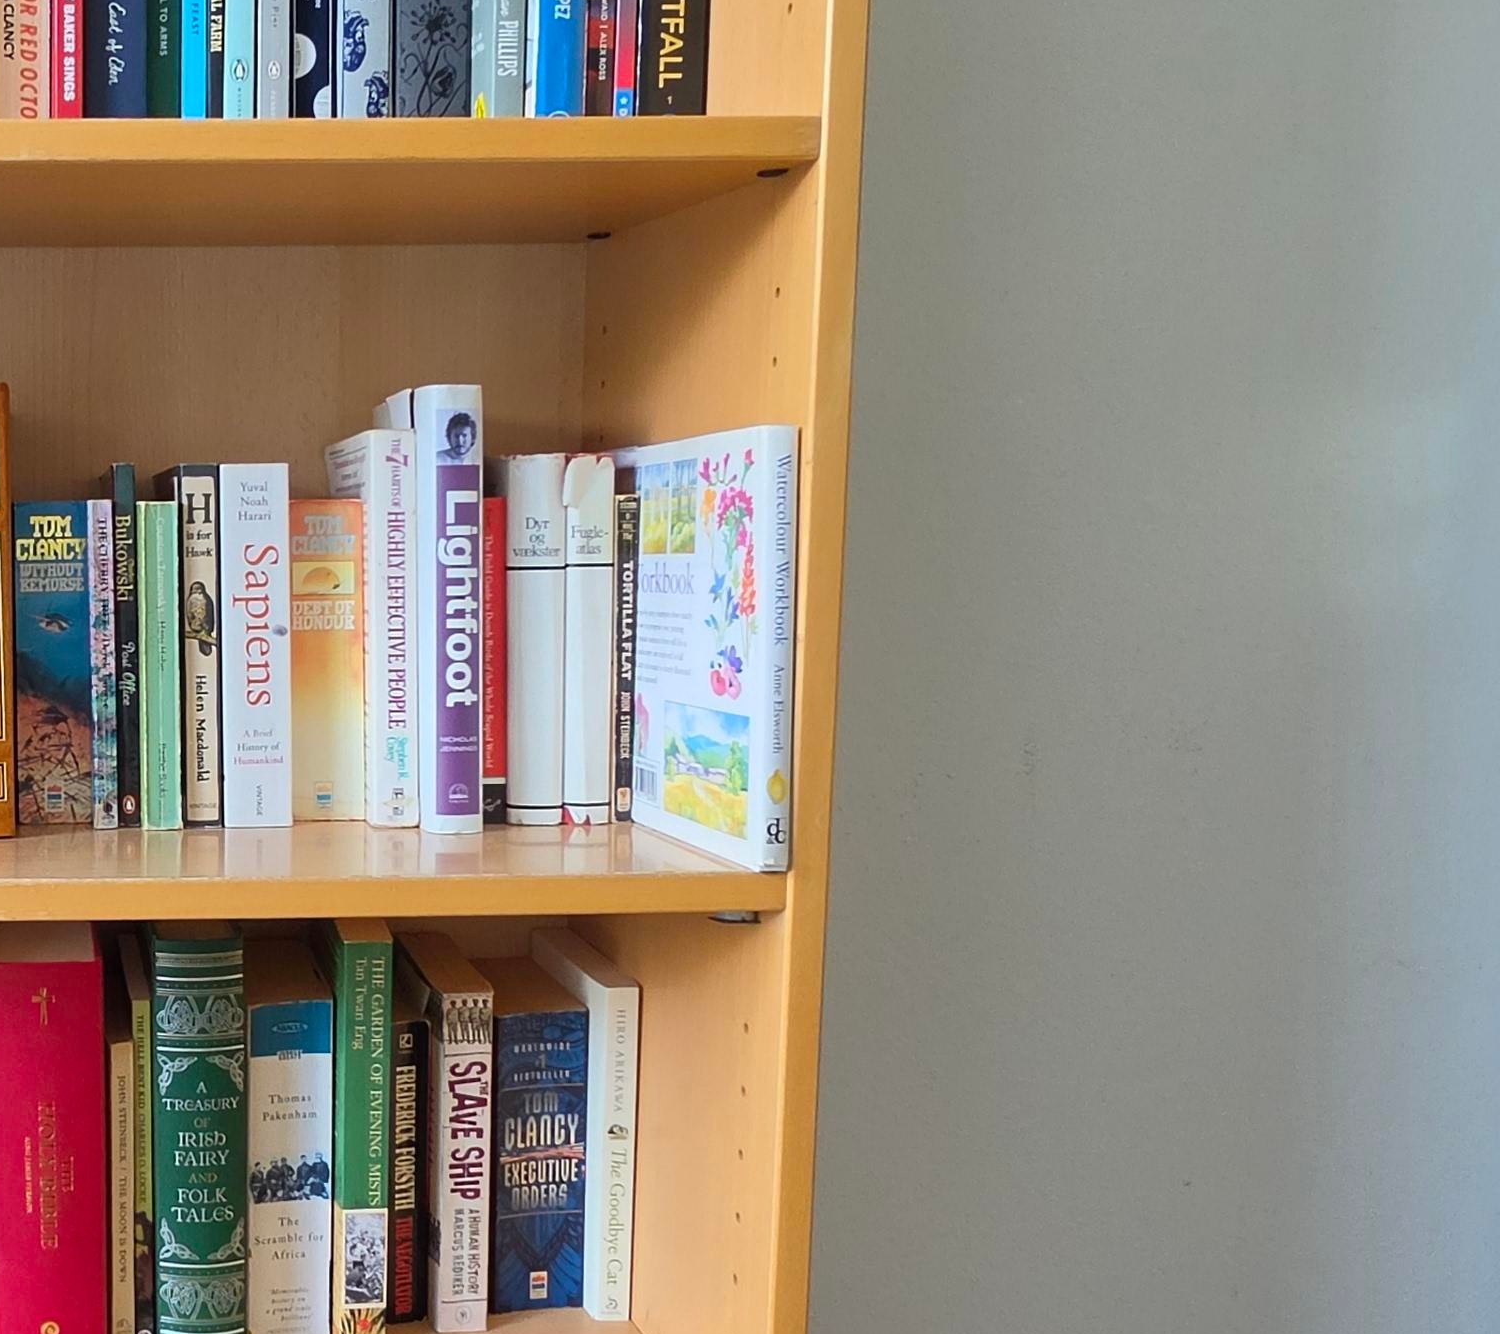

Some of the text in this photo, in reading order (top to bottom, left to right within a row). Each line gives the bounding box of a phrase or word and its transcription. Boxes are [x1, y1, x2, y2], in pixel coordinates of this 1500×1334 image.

[3, 5, 15, 60] CLANCY
[19, 27, 38, 62] RED
[239, 481, 269, 494] Yuval
[186, 492, 212, 525] H
[240, 496, 269, 507] Noah
[29, 515, 72, 538] TOM
[237, 509, 271, 522] Harari
[525, 516, 550, 532] Dyr
[15, 538, 86, 561] CLANCY
[529, 533, 545, 547] og
[115, 515, 132, 602] Bukowski
[512, 545, 560, 559] vækster
[436, 490, 480, 708] Lightfoot
[231, 543, 280, 708] Sapiens
[387, 511, 406, 730] HIGHLY EFFECTIVE PEOPLE
[621, 560, 634, 682] TORTILLA FLAT
[195, 1081, 207, 1094] A
[369, 956, 386, 1207] THE GARDEN OF EVENING MISTS
[162, 1096, 240, 1113] TREASURY
[193, 1118, 211, 1130] OF
[448, 1061, 488, 1200] SLAVE SHIP
[504, 1114, 579, 1148] CLANCY
[173, 1150, 230, 1168] FAIRY
[188, 1170, 218, 1184] AND
[504, 1157, 579, 1188] EXECUTIVE
[177, 1187, 228, 1205] FOLK
[511, 1183, 568, 1211] ORDERS
[171, 1205, 234, 1223] TALES
